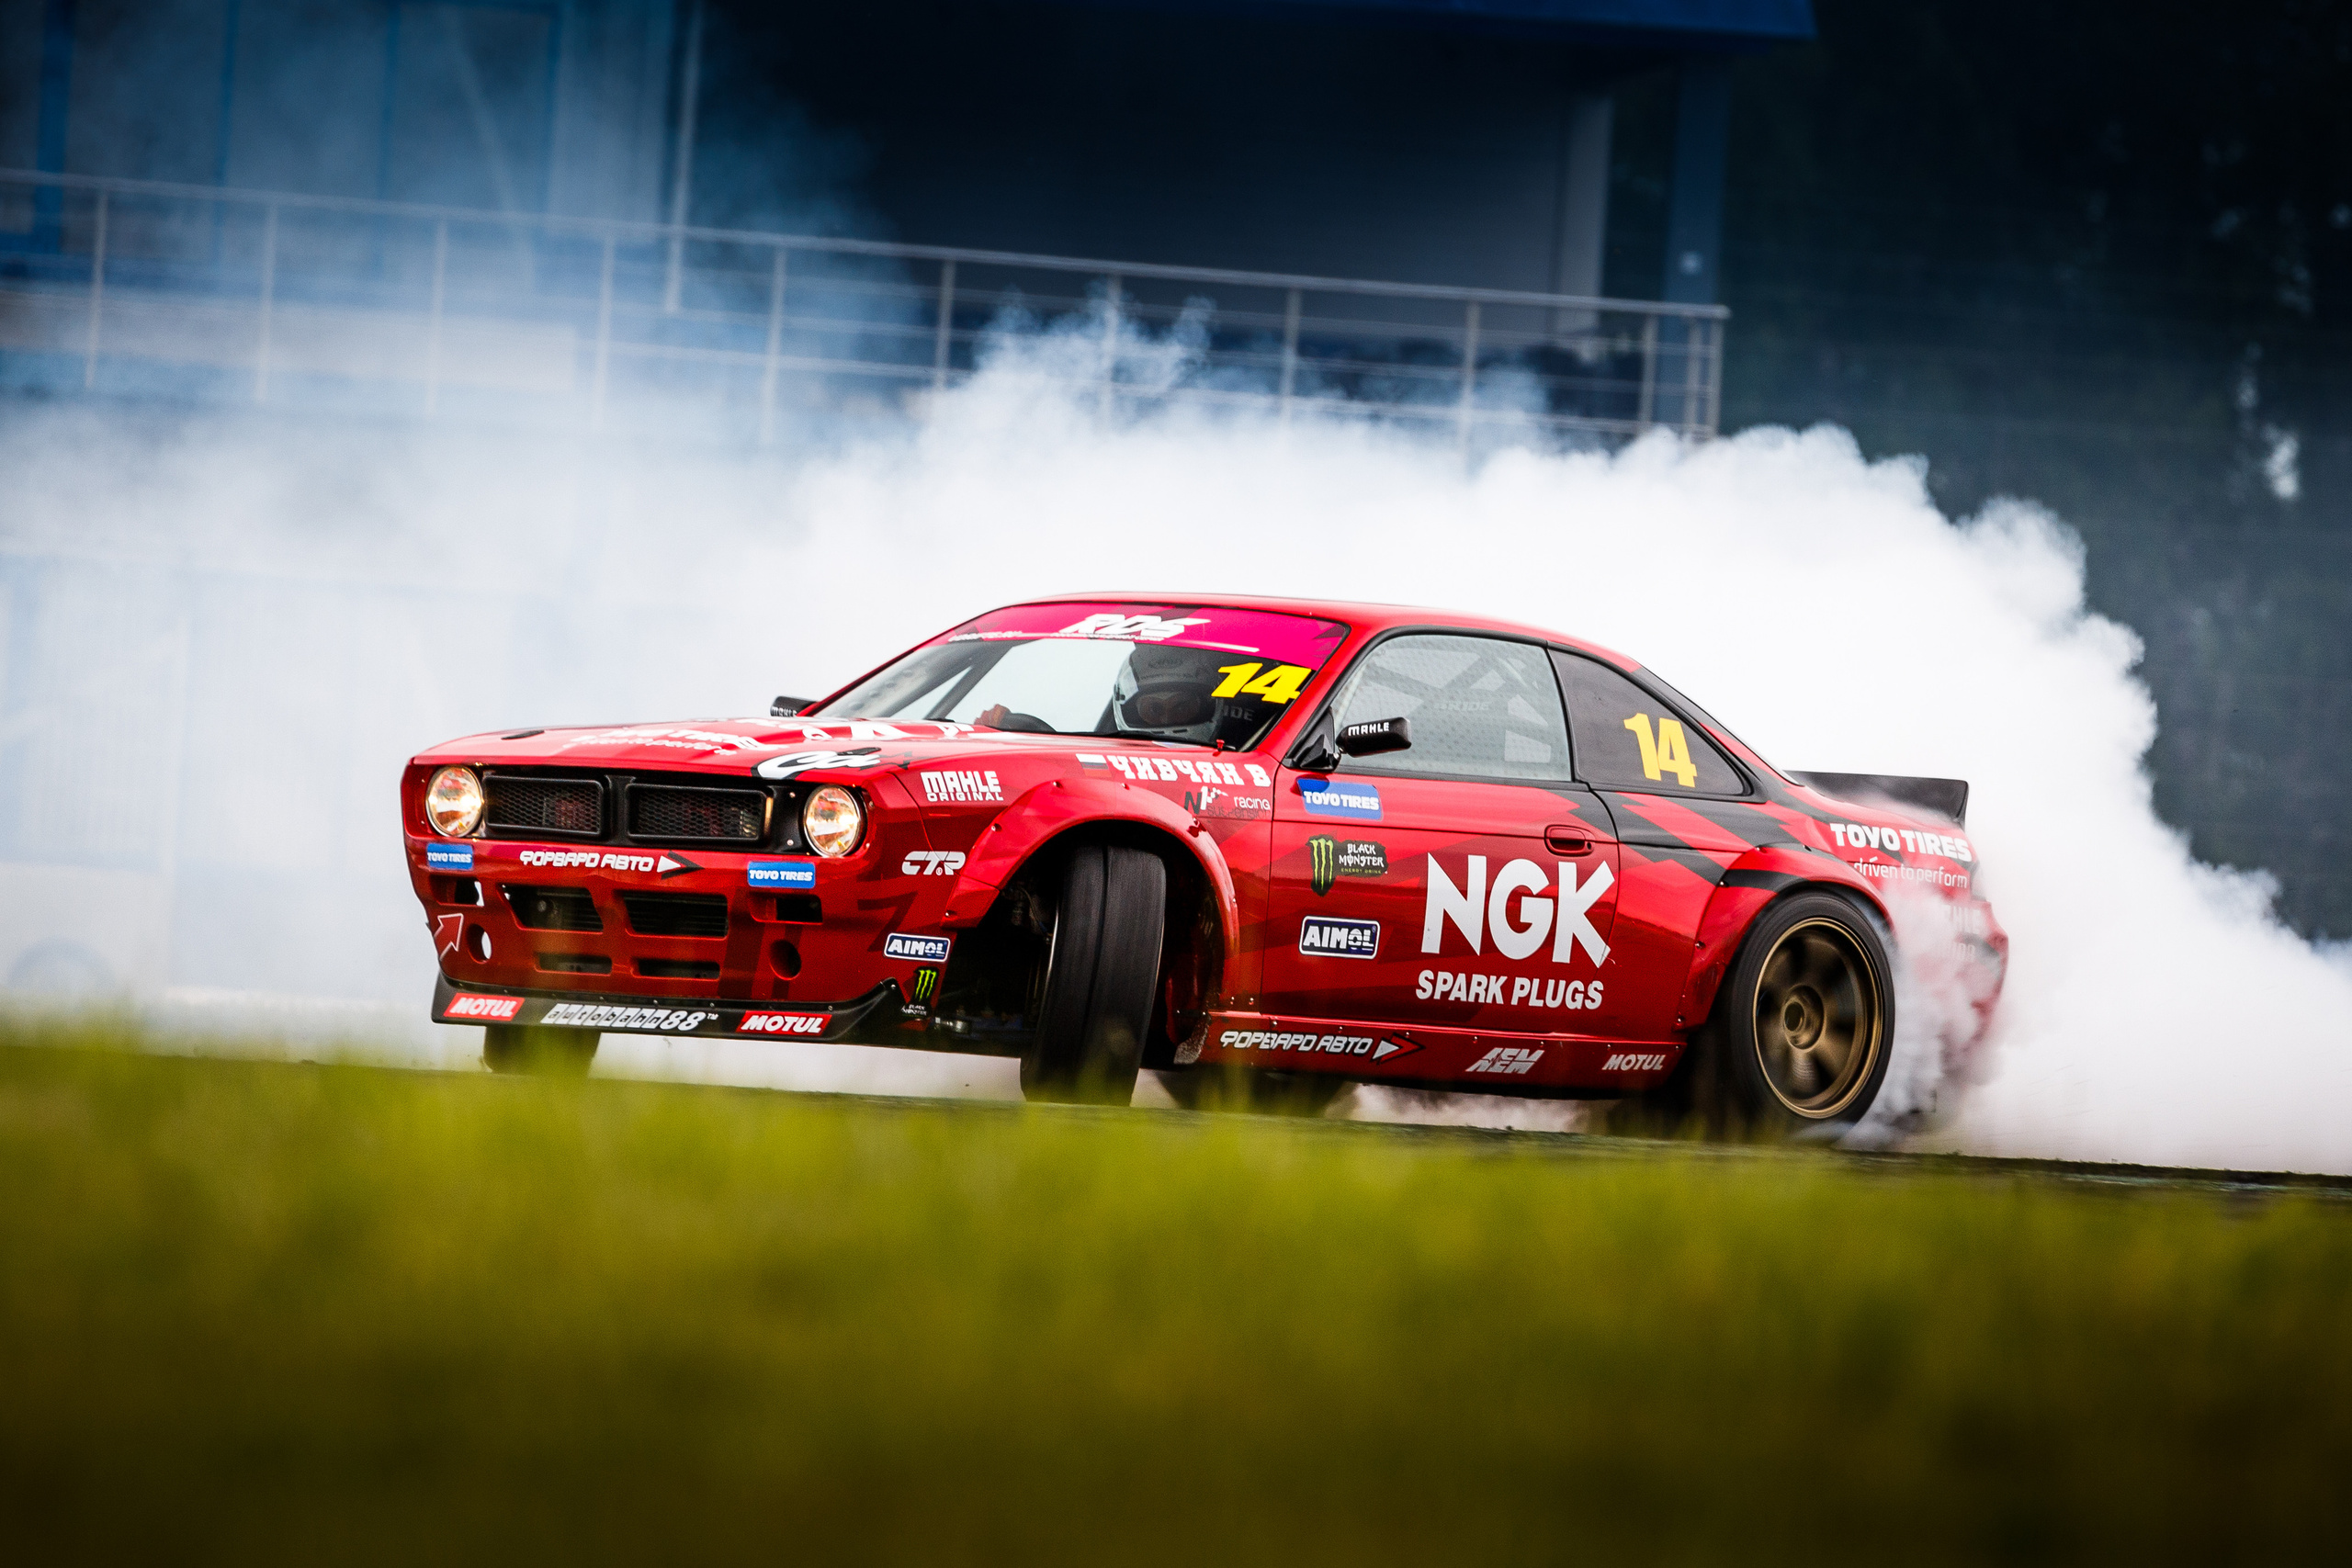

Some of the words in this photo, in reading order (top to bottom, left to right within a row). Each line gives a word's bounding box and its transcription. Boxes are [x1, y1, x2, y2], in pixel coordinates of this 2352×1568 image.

[1058, 614, 1211, 637] RDS
[1211, 662, 1312, 704] 14
[1348, 722, 1390, 736] MAHLE
[1623, 713, 1697, 788] 14
[1106, 755, 1245, 785] ЧИВЧЯН
[920, 771, 1001, 793] MAHLE
[926, 792, 1004, 802] ORIGINAL
[1233, 796, 1272, 810] racing
[1303, 791, 1340, 807] TOYO
[1340, 794, 1380, 810] TIRES
[1347, 843, 1376, 855] BLACK
[1829, 823, 1901, 851] TOYO
[1899, 829, 1973, 862] TIRES
[427, 852, 448, 863] TOYO
[448, 853, 472, 863] TIRES
[901, 851, 966, 875] CTR
[1339, 854, 1385, 868] MONSTER
[749, 870, 779, 880] TOYO
[779, 871, 813, 882] TIRES
[1853, 856, 1898, 879] driven
[1900, 863, 1915, 881] to
[1916, 866, 1967, 889] perform
[1421, 852, 1615, 968] NGK
[888, 939, 945, 957] AIMOL
[1303, 925, 1374, 951] AIMOL
[1415, 969, 1508, 1004] SPARK
[1510, 976, 1604, 1010] PLUGS
[448, 998, 514, 1018] MOTUL
[741, 1013, 826, 1033] MOTUL
[1602, 1054, 1666, 1072] MOTUL
